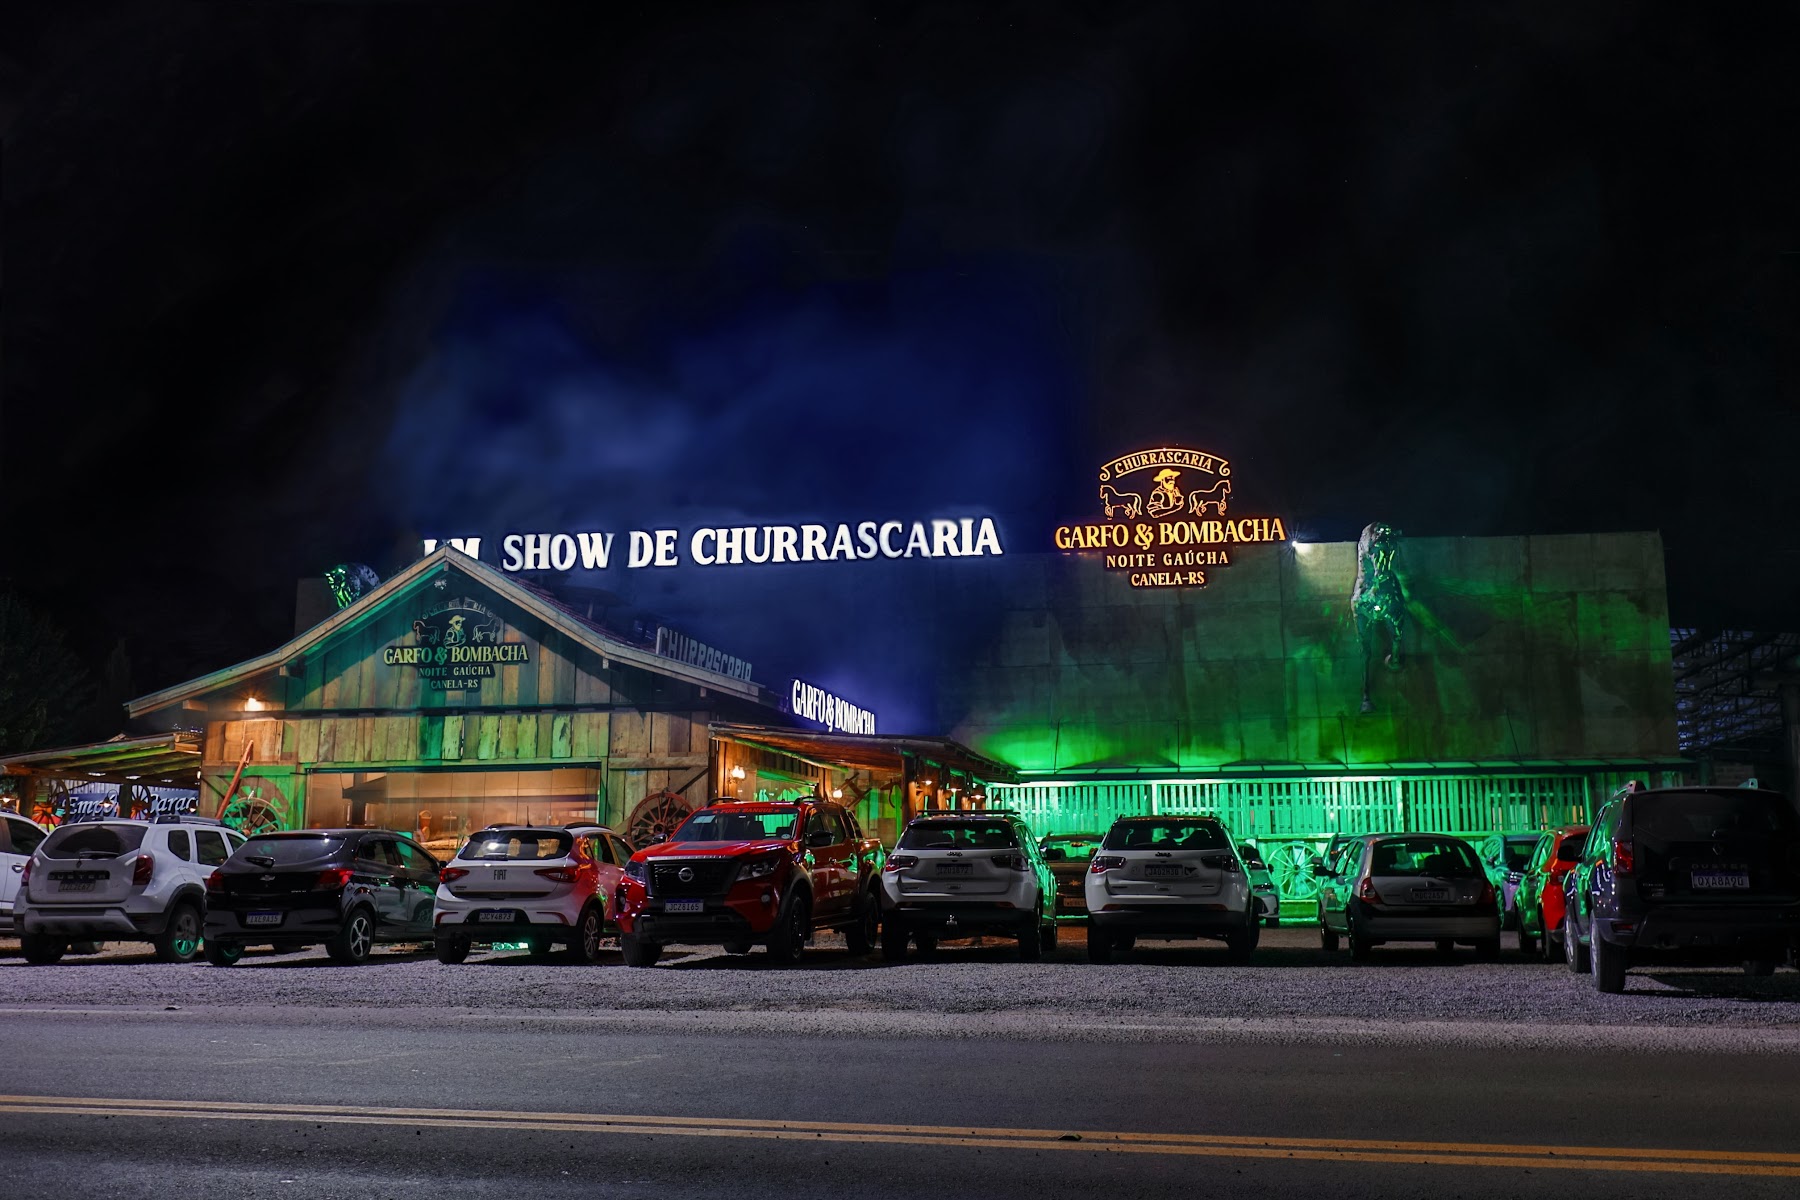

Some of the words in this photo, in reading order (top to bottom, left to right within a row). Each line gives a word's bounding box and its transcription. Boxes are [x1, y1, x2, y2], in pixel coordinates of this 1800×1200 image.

[1114, 451, 1212, 475] CHURRASCARIA
[1055, 523, 1129, 549] GARFO
[1134, 522, 1154, 550] &
[1159, 517, 1286, 545] BOMBACHA
[503, 532, 615, 571] SHOW
[627, 529, 678, 568] DE
[691, 517, 1003, 566] CHURRASCARIA
[1106, 554, 1155, 568] NOITE
[1163, 549, 1229, 566] GAÚCHA
[1131, 571, 1205, 587] CANELA-RS
[383, 647, 433, 664] GARFO
[434, 647, 448, 665] &
[451, 644, 529, 663] BOMBACHA
[418, 667, 447, 677] NOITE
[453, 664, 491, 676] GAÚCHA
[430, 679, 479, 689] CANELA-RS
[792, 679, 826, 724] GARFO
[835, 696, 875, 735] BOMBACHA
[493, 869, 508, 880] FIAT
